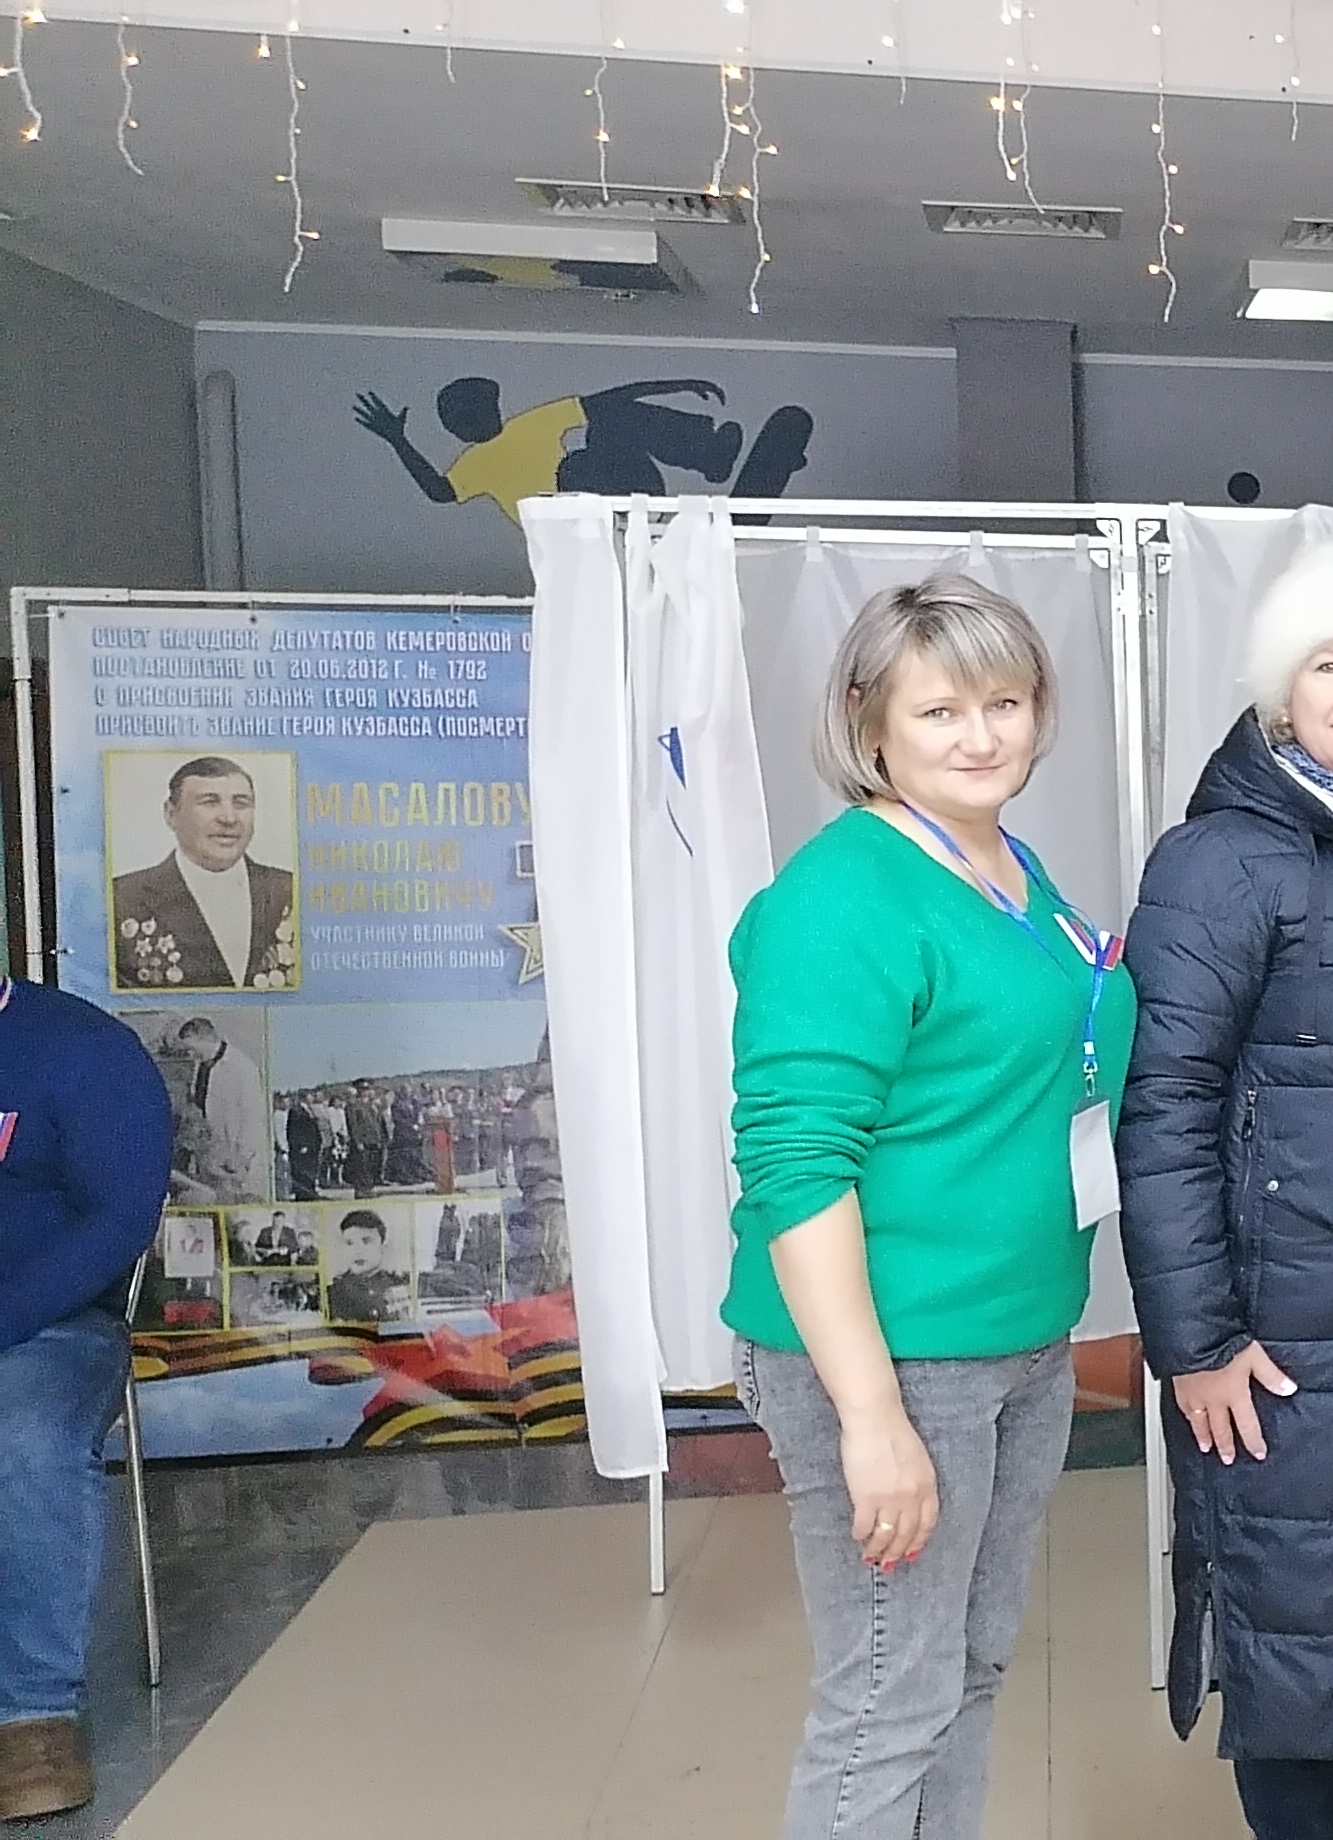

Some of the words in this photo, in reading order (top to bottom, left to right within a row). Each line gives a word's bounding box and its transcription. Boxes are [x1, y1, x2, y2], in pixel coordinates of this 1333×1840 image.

[93, 627, 150, 648] СОВЕТ
[161, 628, 260, 650] НАРОДНЫХ
[271, 629, 375, 652] ДЕПУТАТОВ
[387, 630, 511, 652] КЕМЕРОВСКОЙ
[93, 657, 245, 678] ПОСТАНОВЛЕНИЕ
[254, 659, 276, 679] ОТ
[288, 659, 388, 680] 20.06.2012
[448, 660, 487, 680] 1792
[95, 686, 104, 706] О
[117, 686, 232, 708] ПРИСВОЕНИИ
[245, 687, 314, 708] ЗВАНИЯ
[325, 688, 377, 708] ГЕРОЯ
[388, 688, 478, 709] КУЗБАССА
[96, 715, 199, 736] ПРИСВОИТЬ
[208, 716, 274, 737] ЗВАНИЕ
[282, 716, 335, 737] ГЕРОЯ
[342, 716, 432, 737] КУЗБАССА
[437, 716, 526, 738] (ПОСМЕРТ
[306, 781, 531, 828] МАСАЛОВУ
[308, 839, 462, 873] НИКОЛАЮ
[309, 879, 495, 914] ИВАНОВИЧУ
[310, 924, 407, 943] УЧАСТНИКУ
[413, 923, 484, 942] ВЕЛИКОЙ
[311, 950, 444, 970] ОТЕЧЕСТВЕННОЙ
[450, 949, 504, 968] ВОЙНЫ
